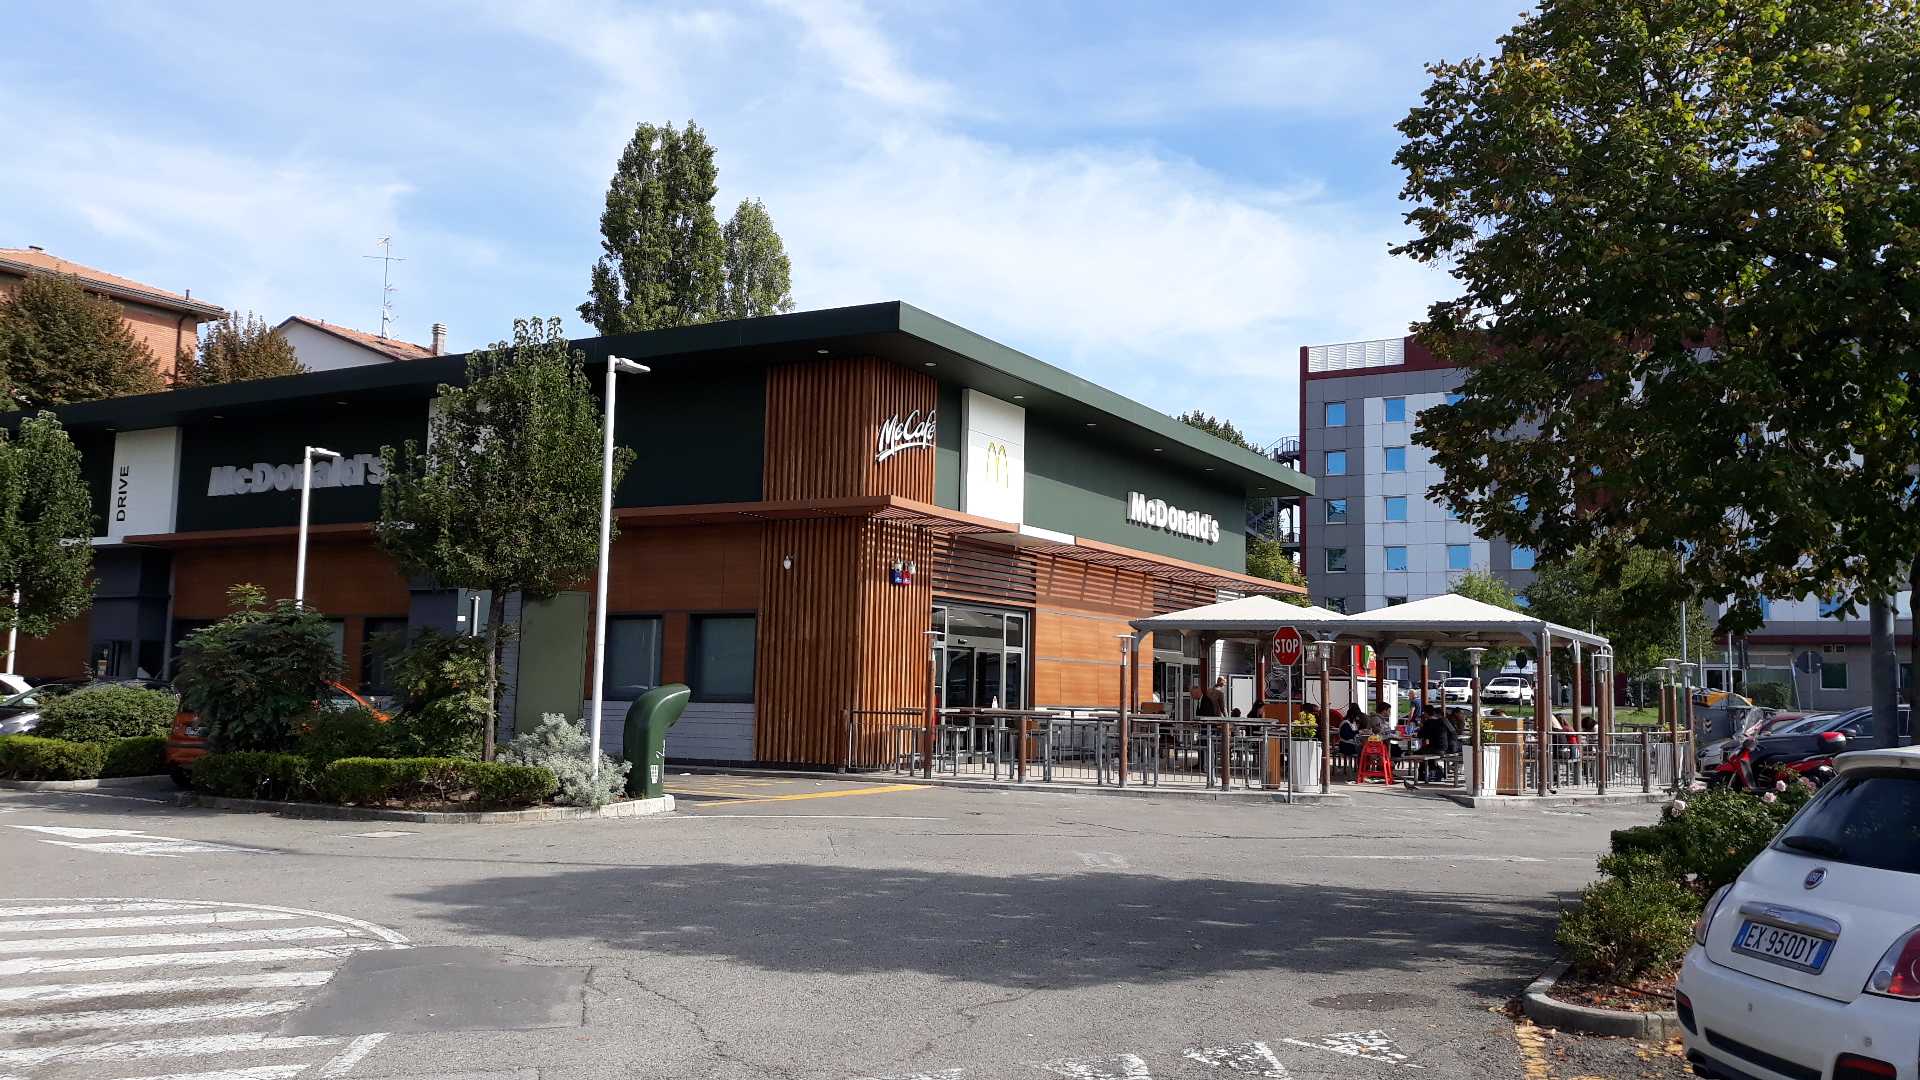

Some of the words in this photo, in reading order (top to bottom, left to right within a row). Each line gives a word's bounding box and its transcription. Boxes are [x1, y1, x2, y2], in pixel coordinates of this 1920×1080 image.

[116, 465, 130, 522] DRIVE
[1126, 491, 1220, 543] McDonald's
[1274, 638, 1299, 654] STOP
